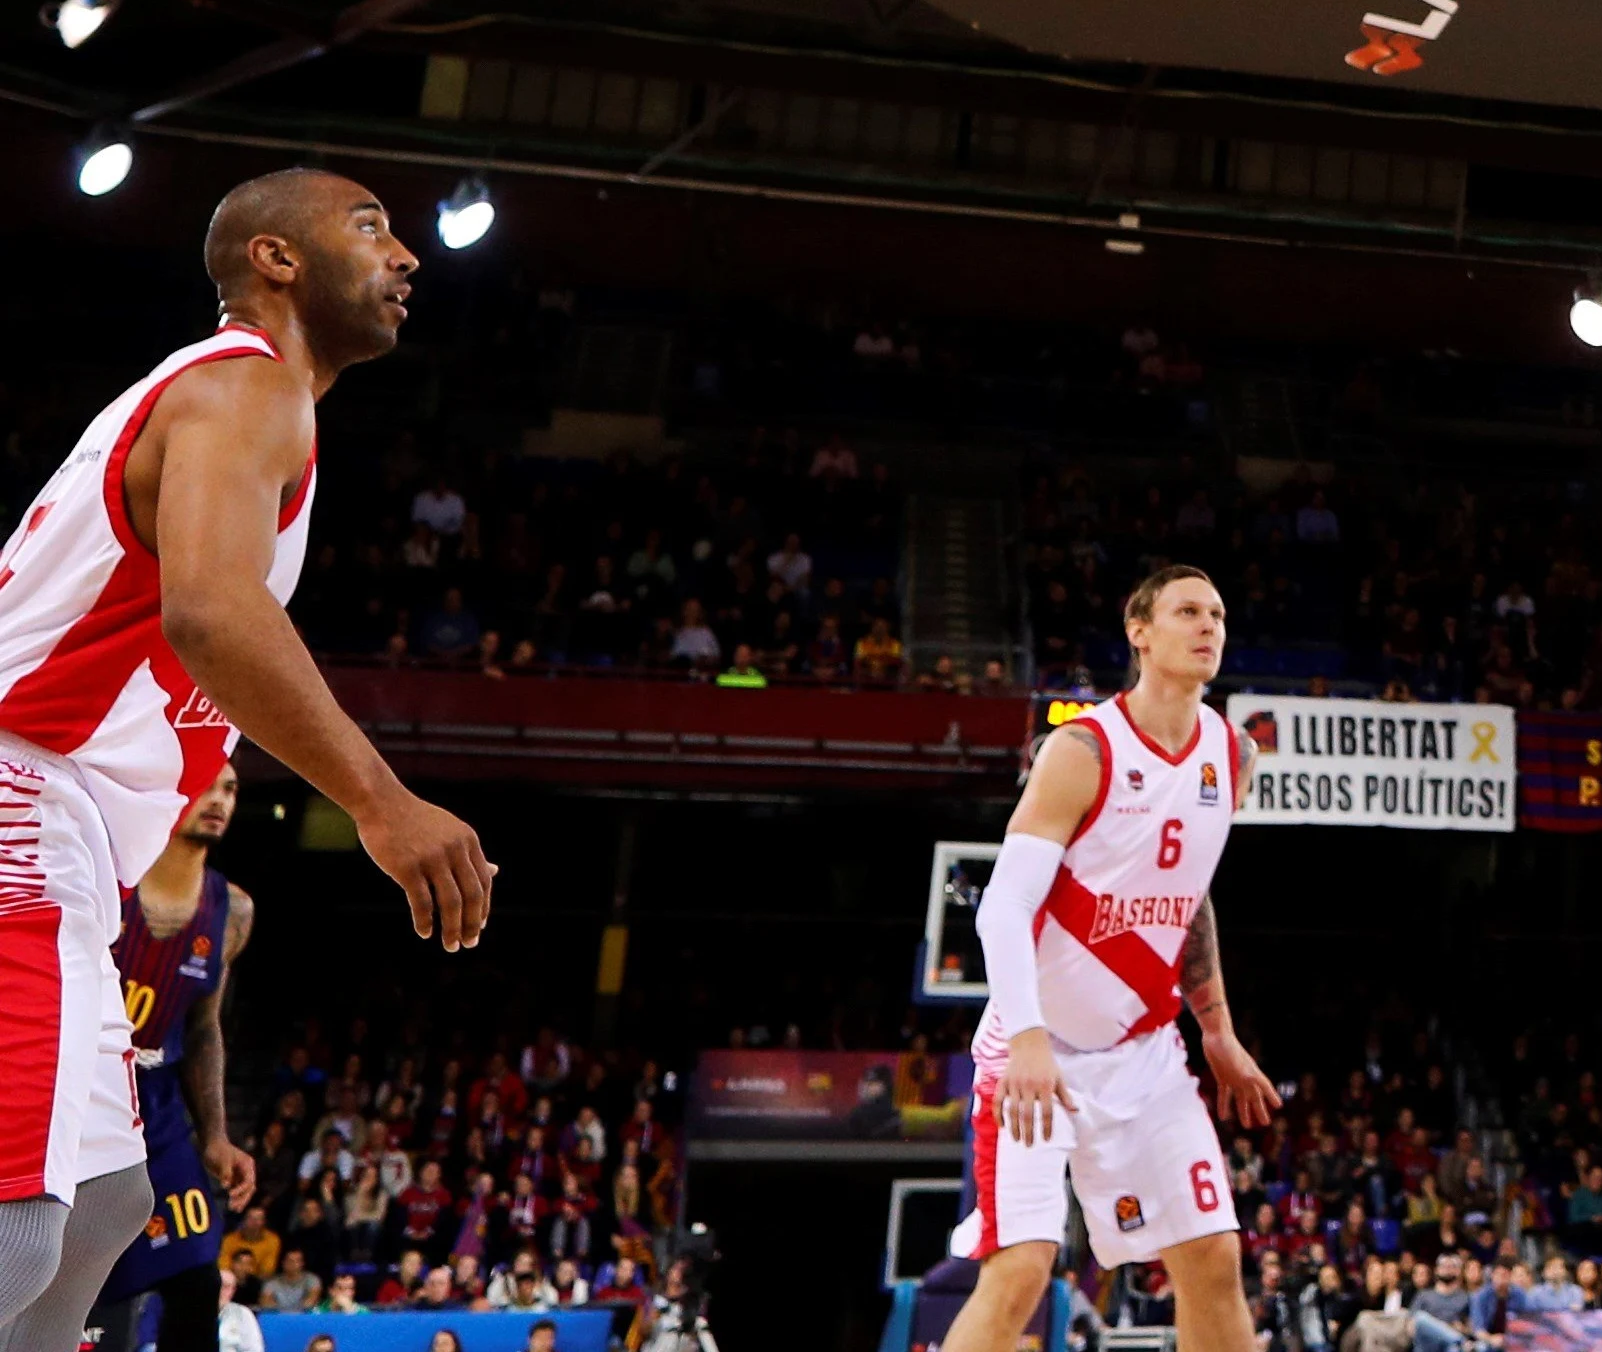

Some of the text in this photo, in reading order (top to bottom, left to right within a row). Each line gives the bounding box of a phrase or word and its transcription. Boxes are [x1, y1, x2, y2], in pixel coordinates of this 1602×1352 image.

[1293, 714, 1459, 760] LLIBERTAT
[1247, 768, 1505, 818] RESOS POLÍTICS!
[1157, 818, 1183, 870] 6
[1188, 1160, 1220, 1213] 6
[165, 1188, 210, 1240] 10
